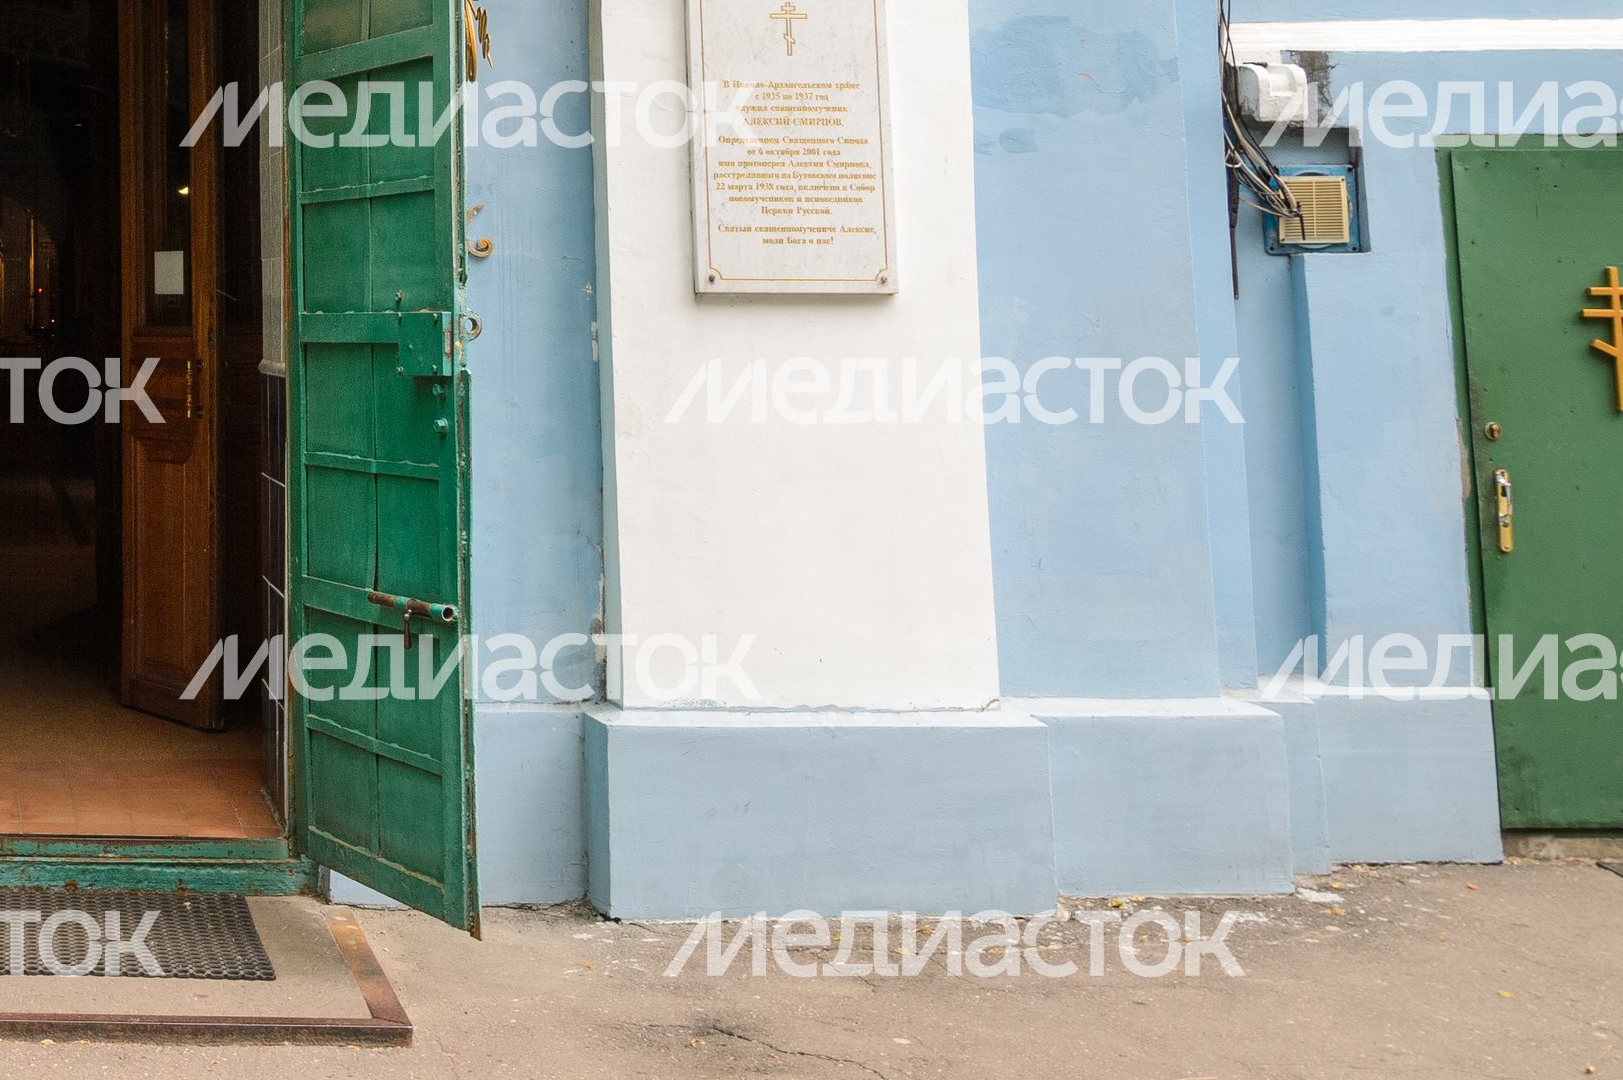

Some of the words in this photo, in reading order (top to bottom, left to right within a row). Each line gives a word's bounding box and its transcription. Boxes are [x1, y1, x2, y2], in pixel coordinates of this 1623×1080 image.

[723, 80, 730, 88] В
[835, 82, 860, 91] храме
[762, 92, 780, 100] 1935
[796, 92, 814, 100] 1937
[771, 105, 848, 113] священномученик
[782, 136, 835, 145] Священного
[837, 136, 869, 145] Синода
[766, 148, 800, 157] октября
[802, 148, 820, 156] 2001
[738, 161, 785, 169] протоиерея
[788, 160, 823, 168] Алексия
[713, 172, 779, 181] расстрелянного
[793, 171, 837, 181] Бутовском
[716, 182, 726, 190] 22
[728, 184, 753, 192] марта
[756, 182, 774, 190] 1938
[850, 183, 876, 194] Собор
[729, 196, 794, 204] новомучеников
[804, 196, 864, 204] исповедников
[761, 206, 794, 216] Церкви
[718, 223, 752, 233] Святый
[755, 225, 836, 234] священномучениче
[786, 236, 806, 245] Бога
[816, 236, 834, 245] нас!
